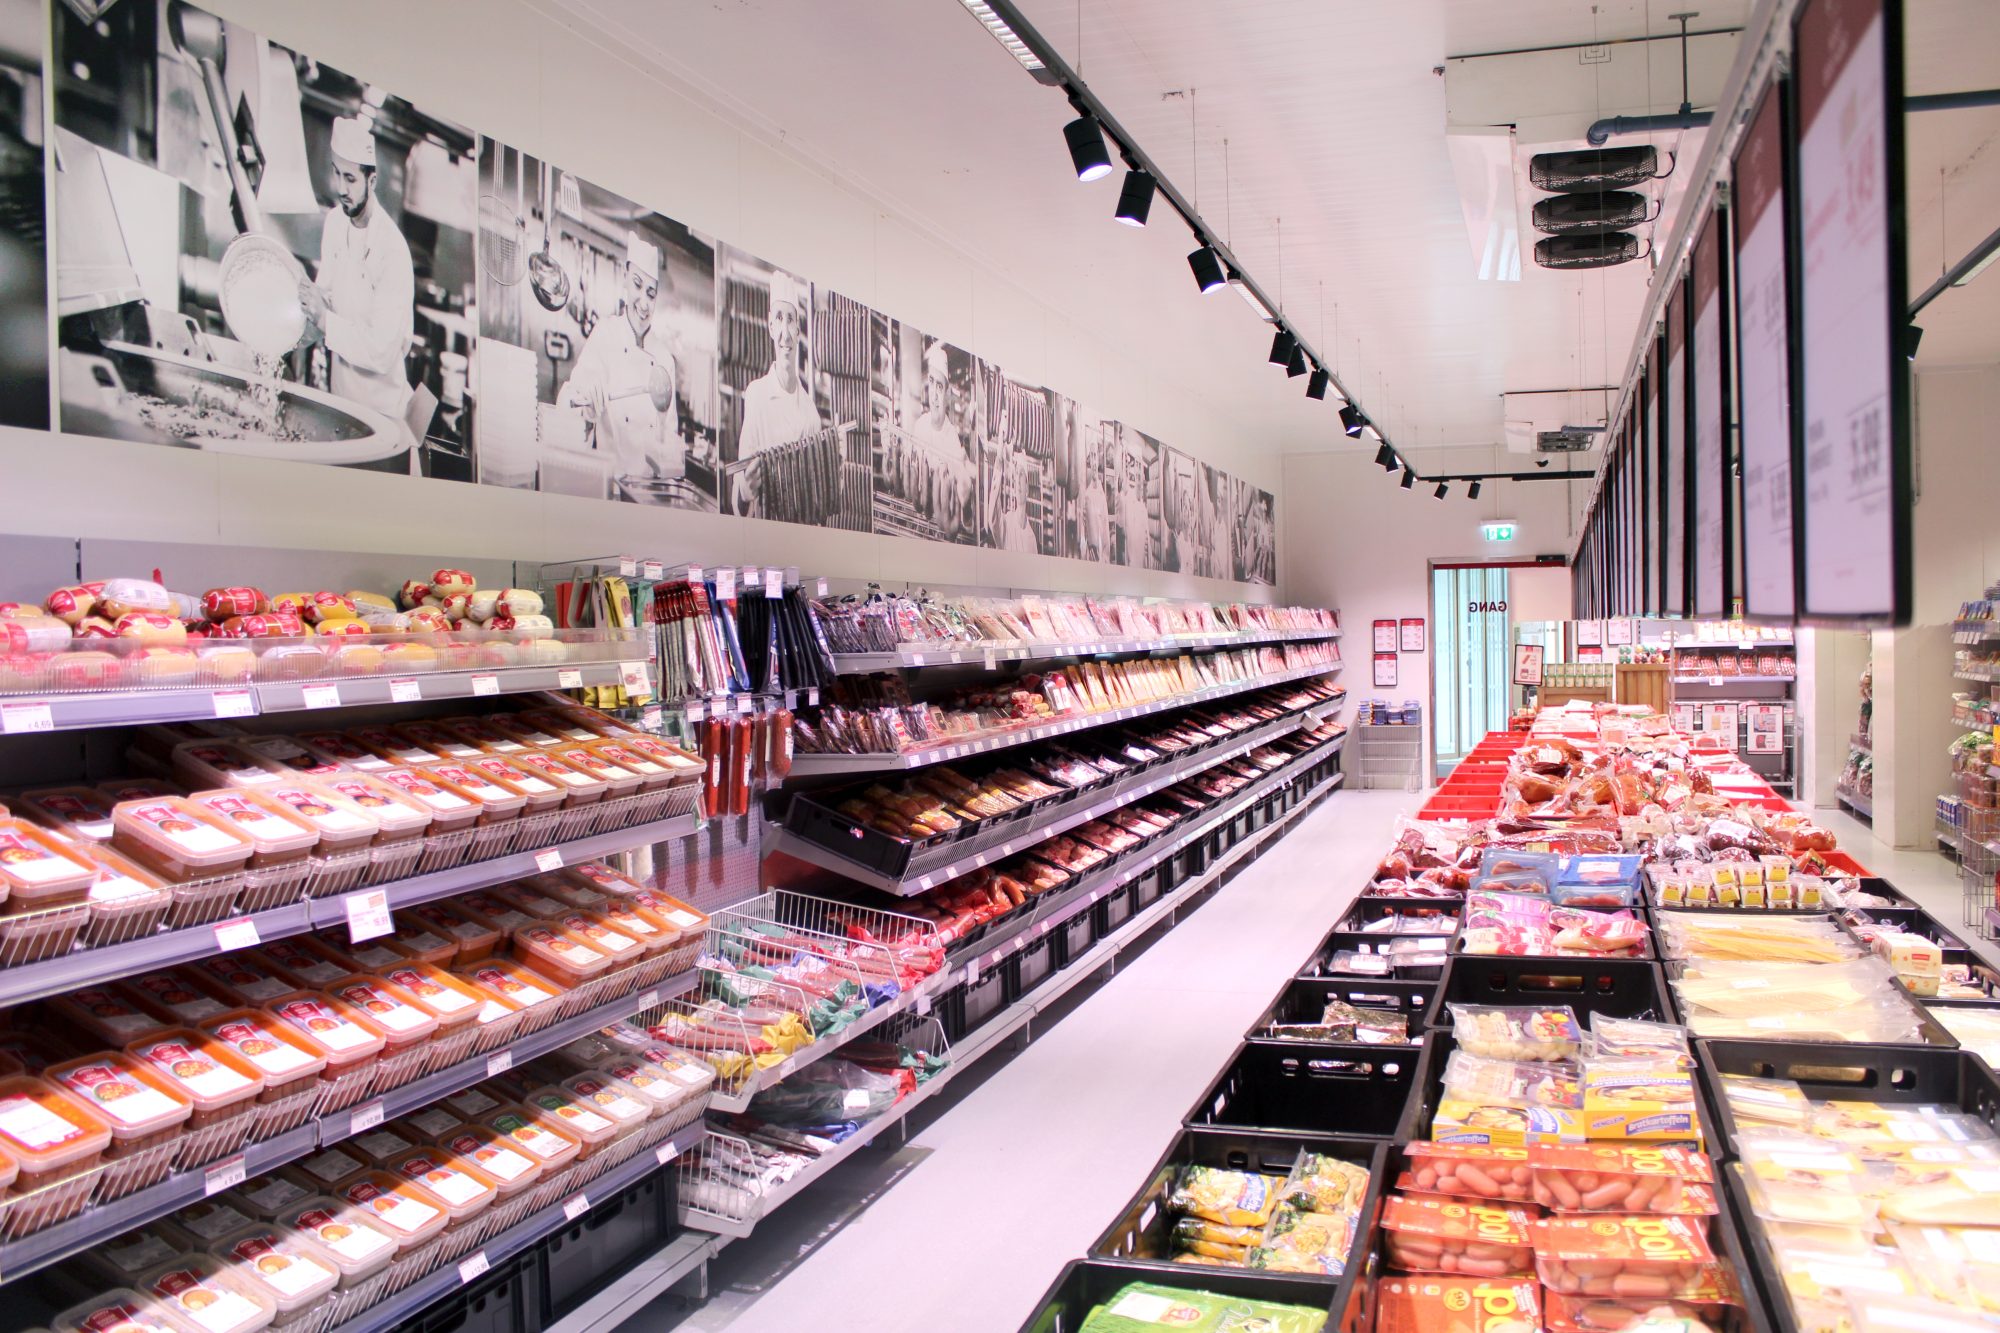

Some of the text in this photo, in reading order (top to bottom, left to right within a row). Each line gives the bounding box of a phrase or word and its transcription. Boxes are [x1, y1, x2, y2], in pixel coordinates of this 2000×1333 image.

[228, 1172, 243, 1184] 9,99
[1469, 1206, 1519, 1244] poli
[1621, 1218, 1692, 1261] poli
